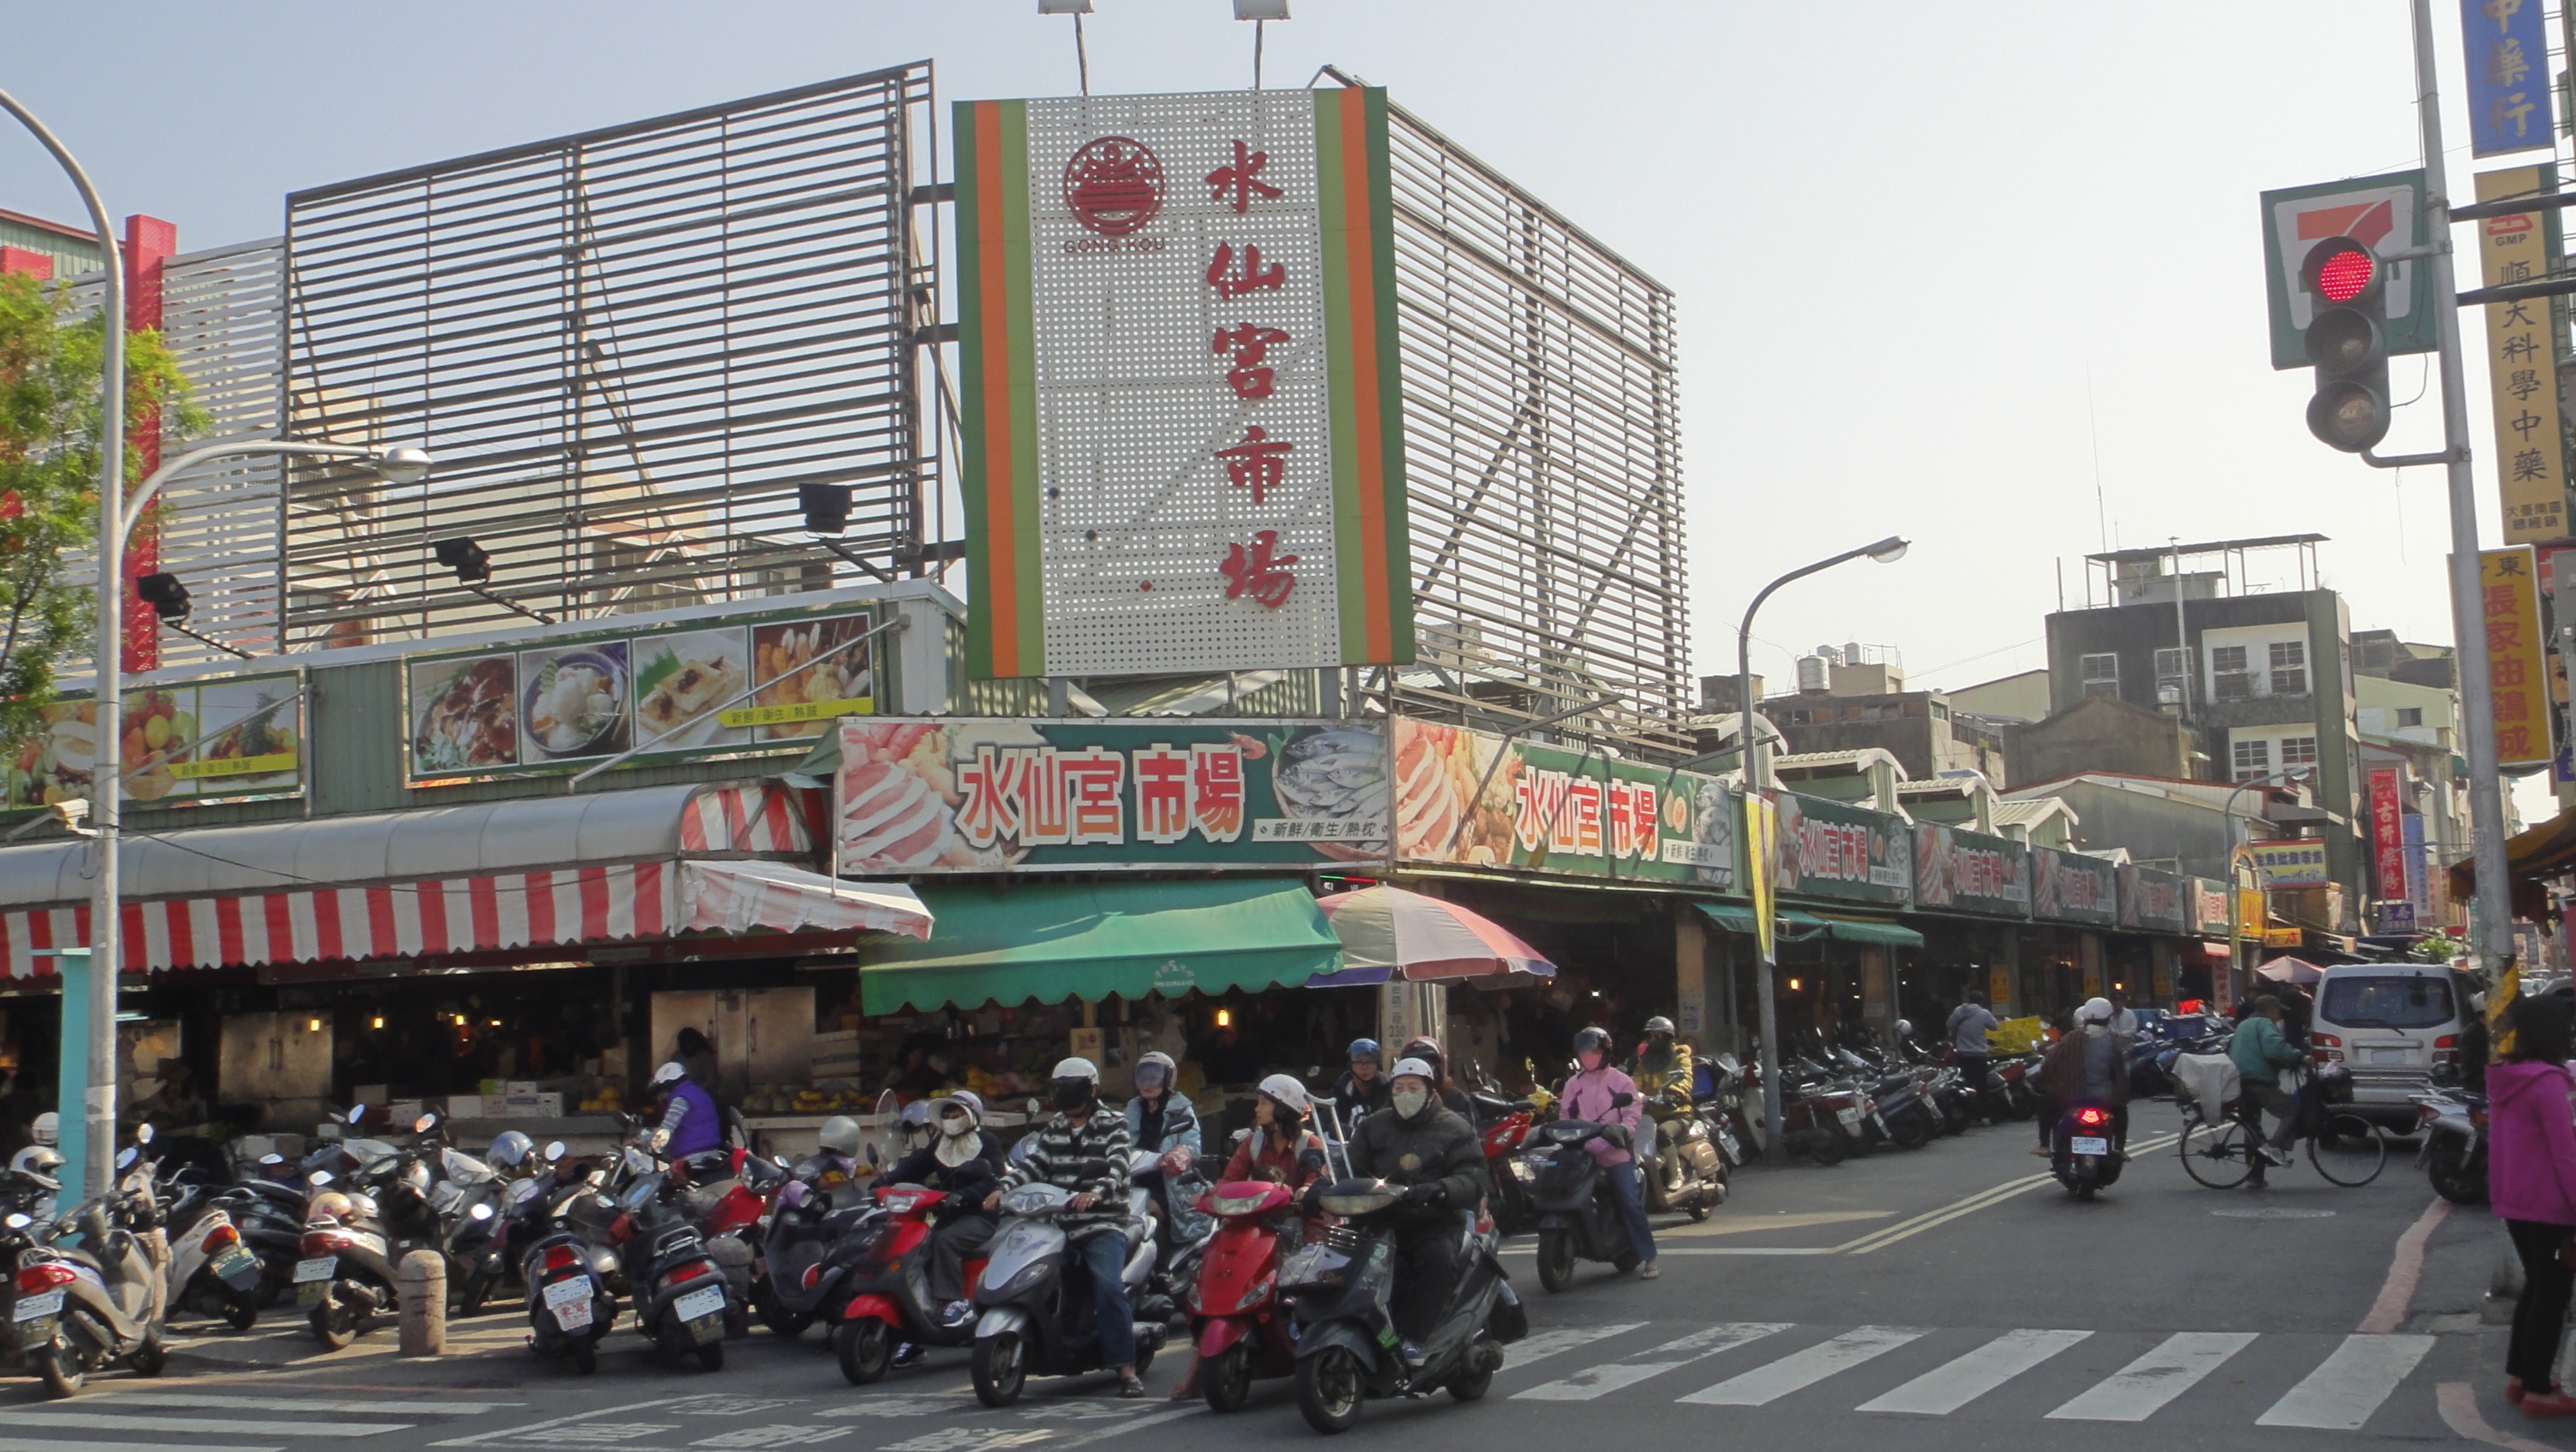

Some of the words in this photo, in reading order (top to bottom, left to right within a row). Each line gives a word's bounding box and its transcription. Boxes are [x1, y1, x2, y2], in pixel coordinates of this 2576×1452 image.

[1063, 239, 1119, 253] GONG
[2496, 234, 2527, 247] GMP
[1204, 138, 1299, 608] 水仙宮市場
[1515, 766, 1659, 861] 水仙宮市場
[1799, 816, 1868, 883] 水仙宮市場
